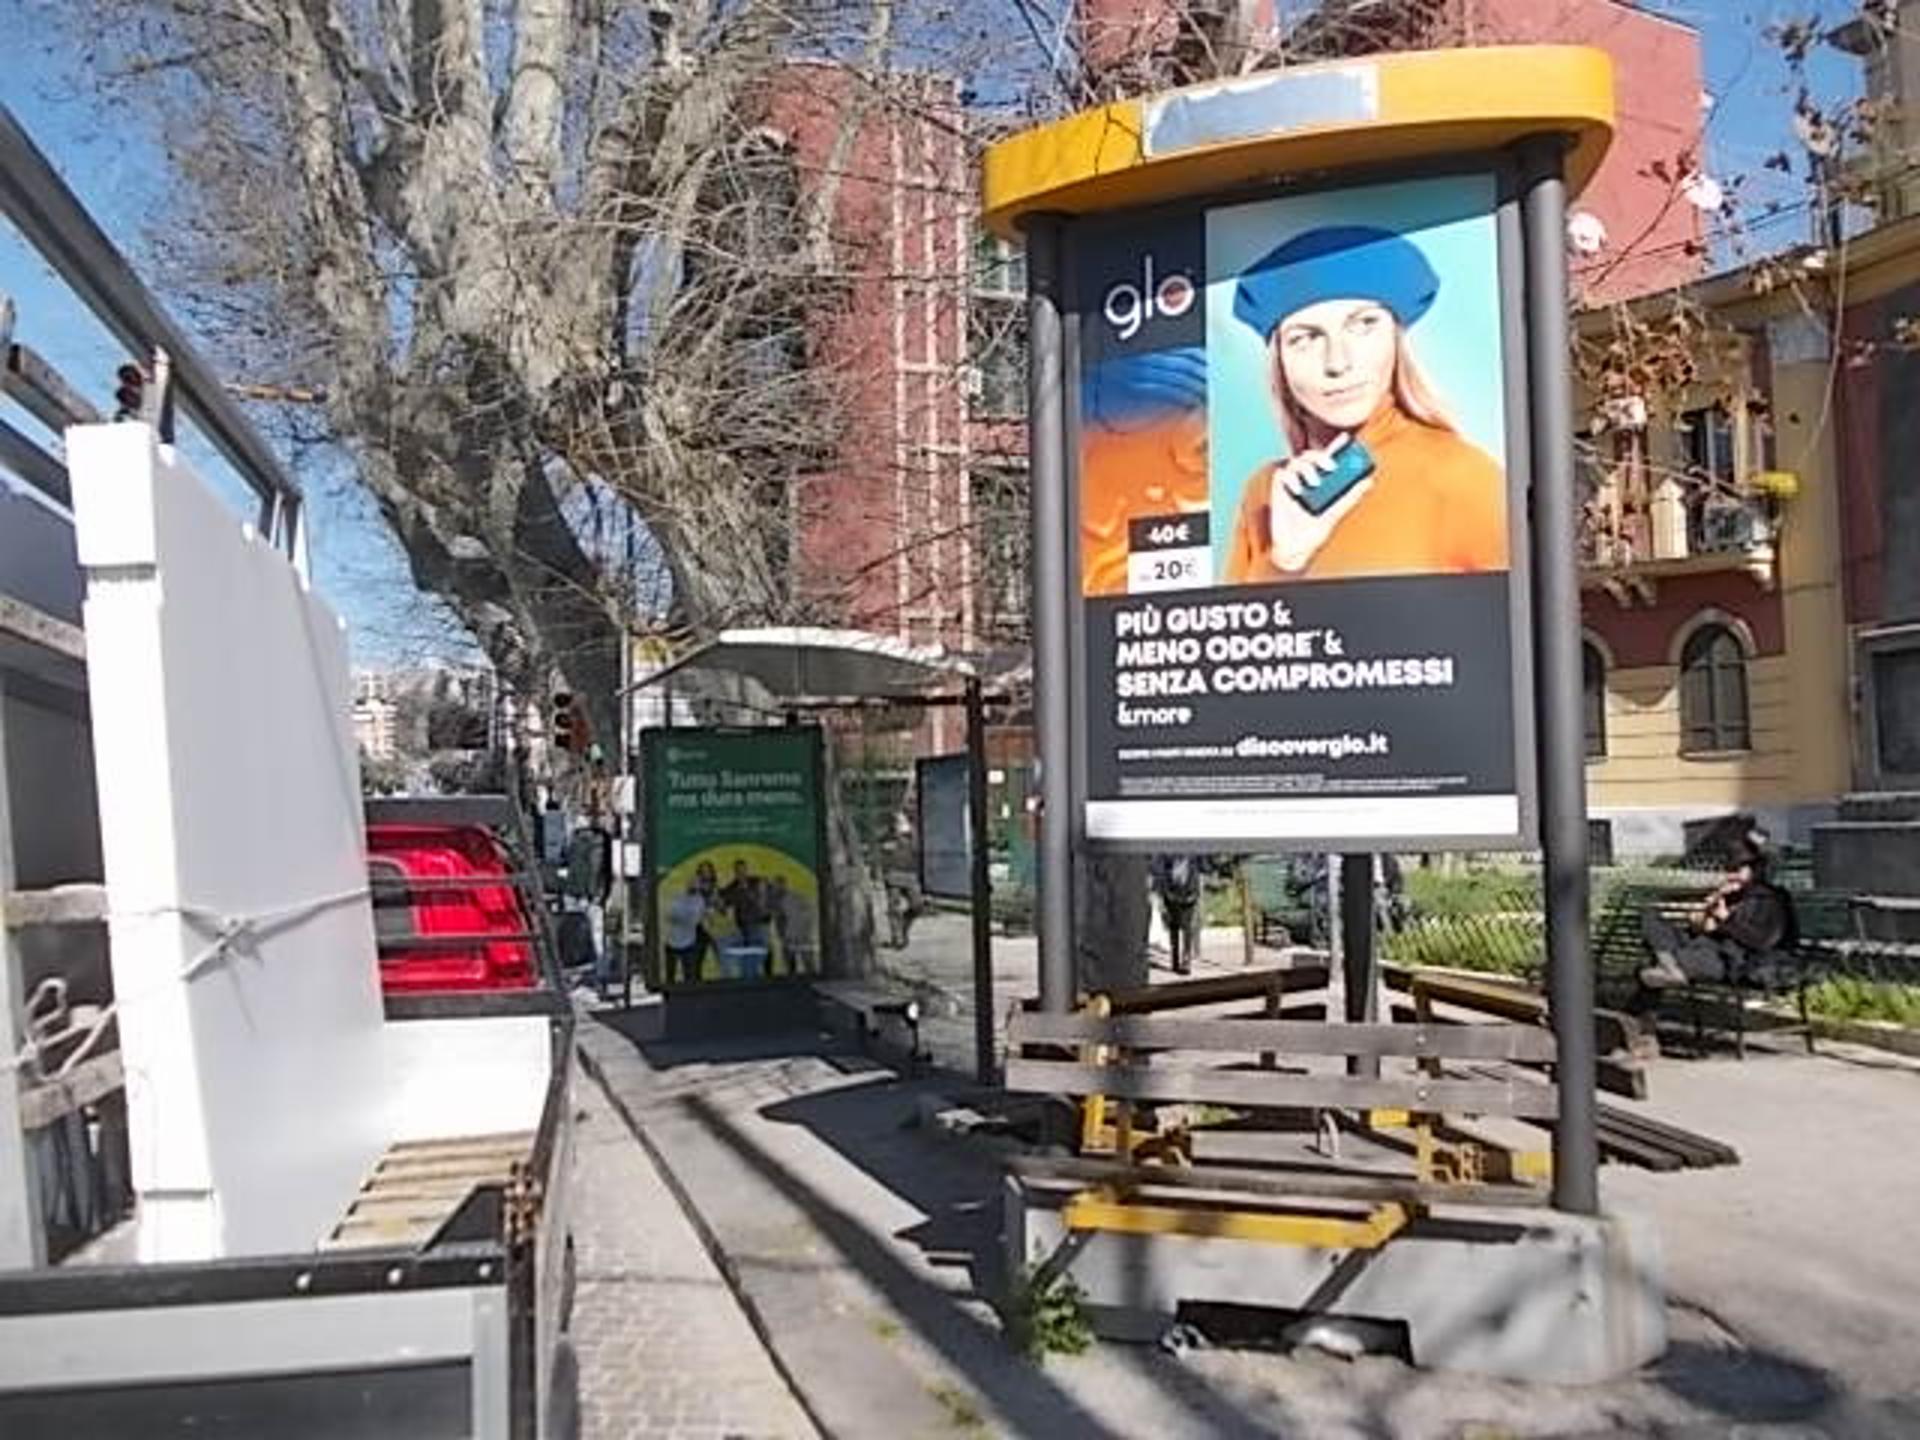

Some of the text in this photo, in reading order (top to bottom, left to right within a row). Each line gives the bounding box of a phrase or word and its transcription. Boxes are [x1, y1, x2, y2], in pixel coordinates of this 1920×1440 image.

[1104, 254, 1195, 340] glo
[1116, 600, 1292, 637] PIÙ GUSTO &
[1116, 638, 1201, 667] MENO
[1323, 629, 1345, 656] &
[1116, 657, 1454, 698] SENZA COMPROMESSI
